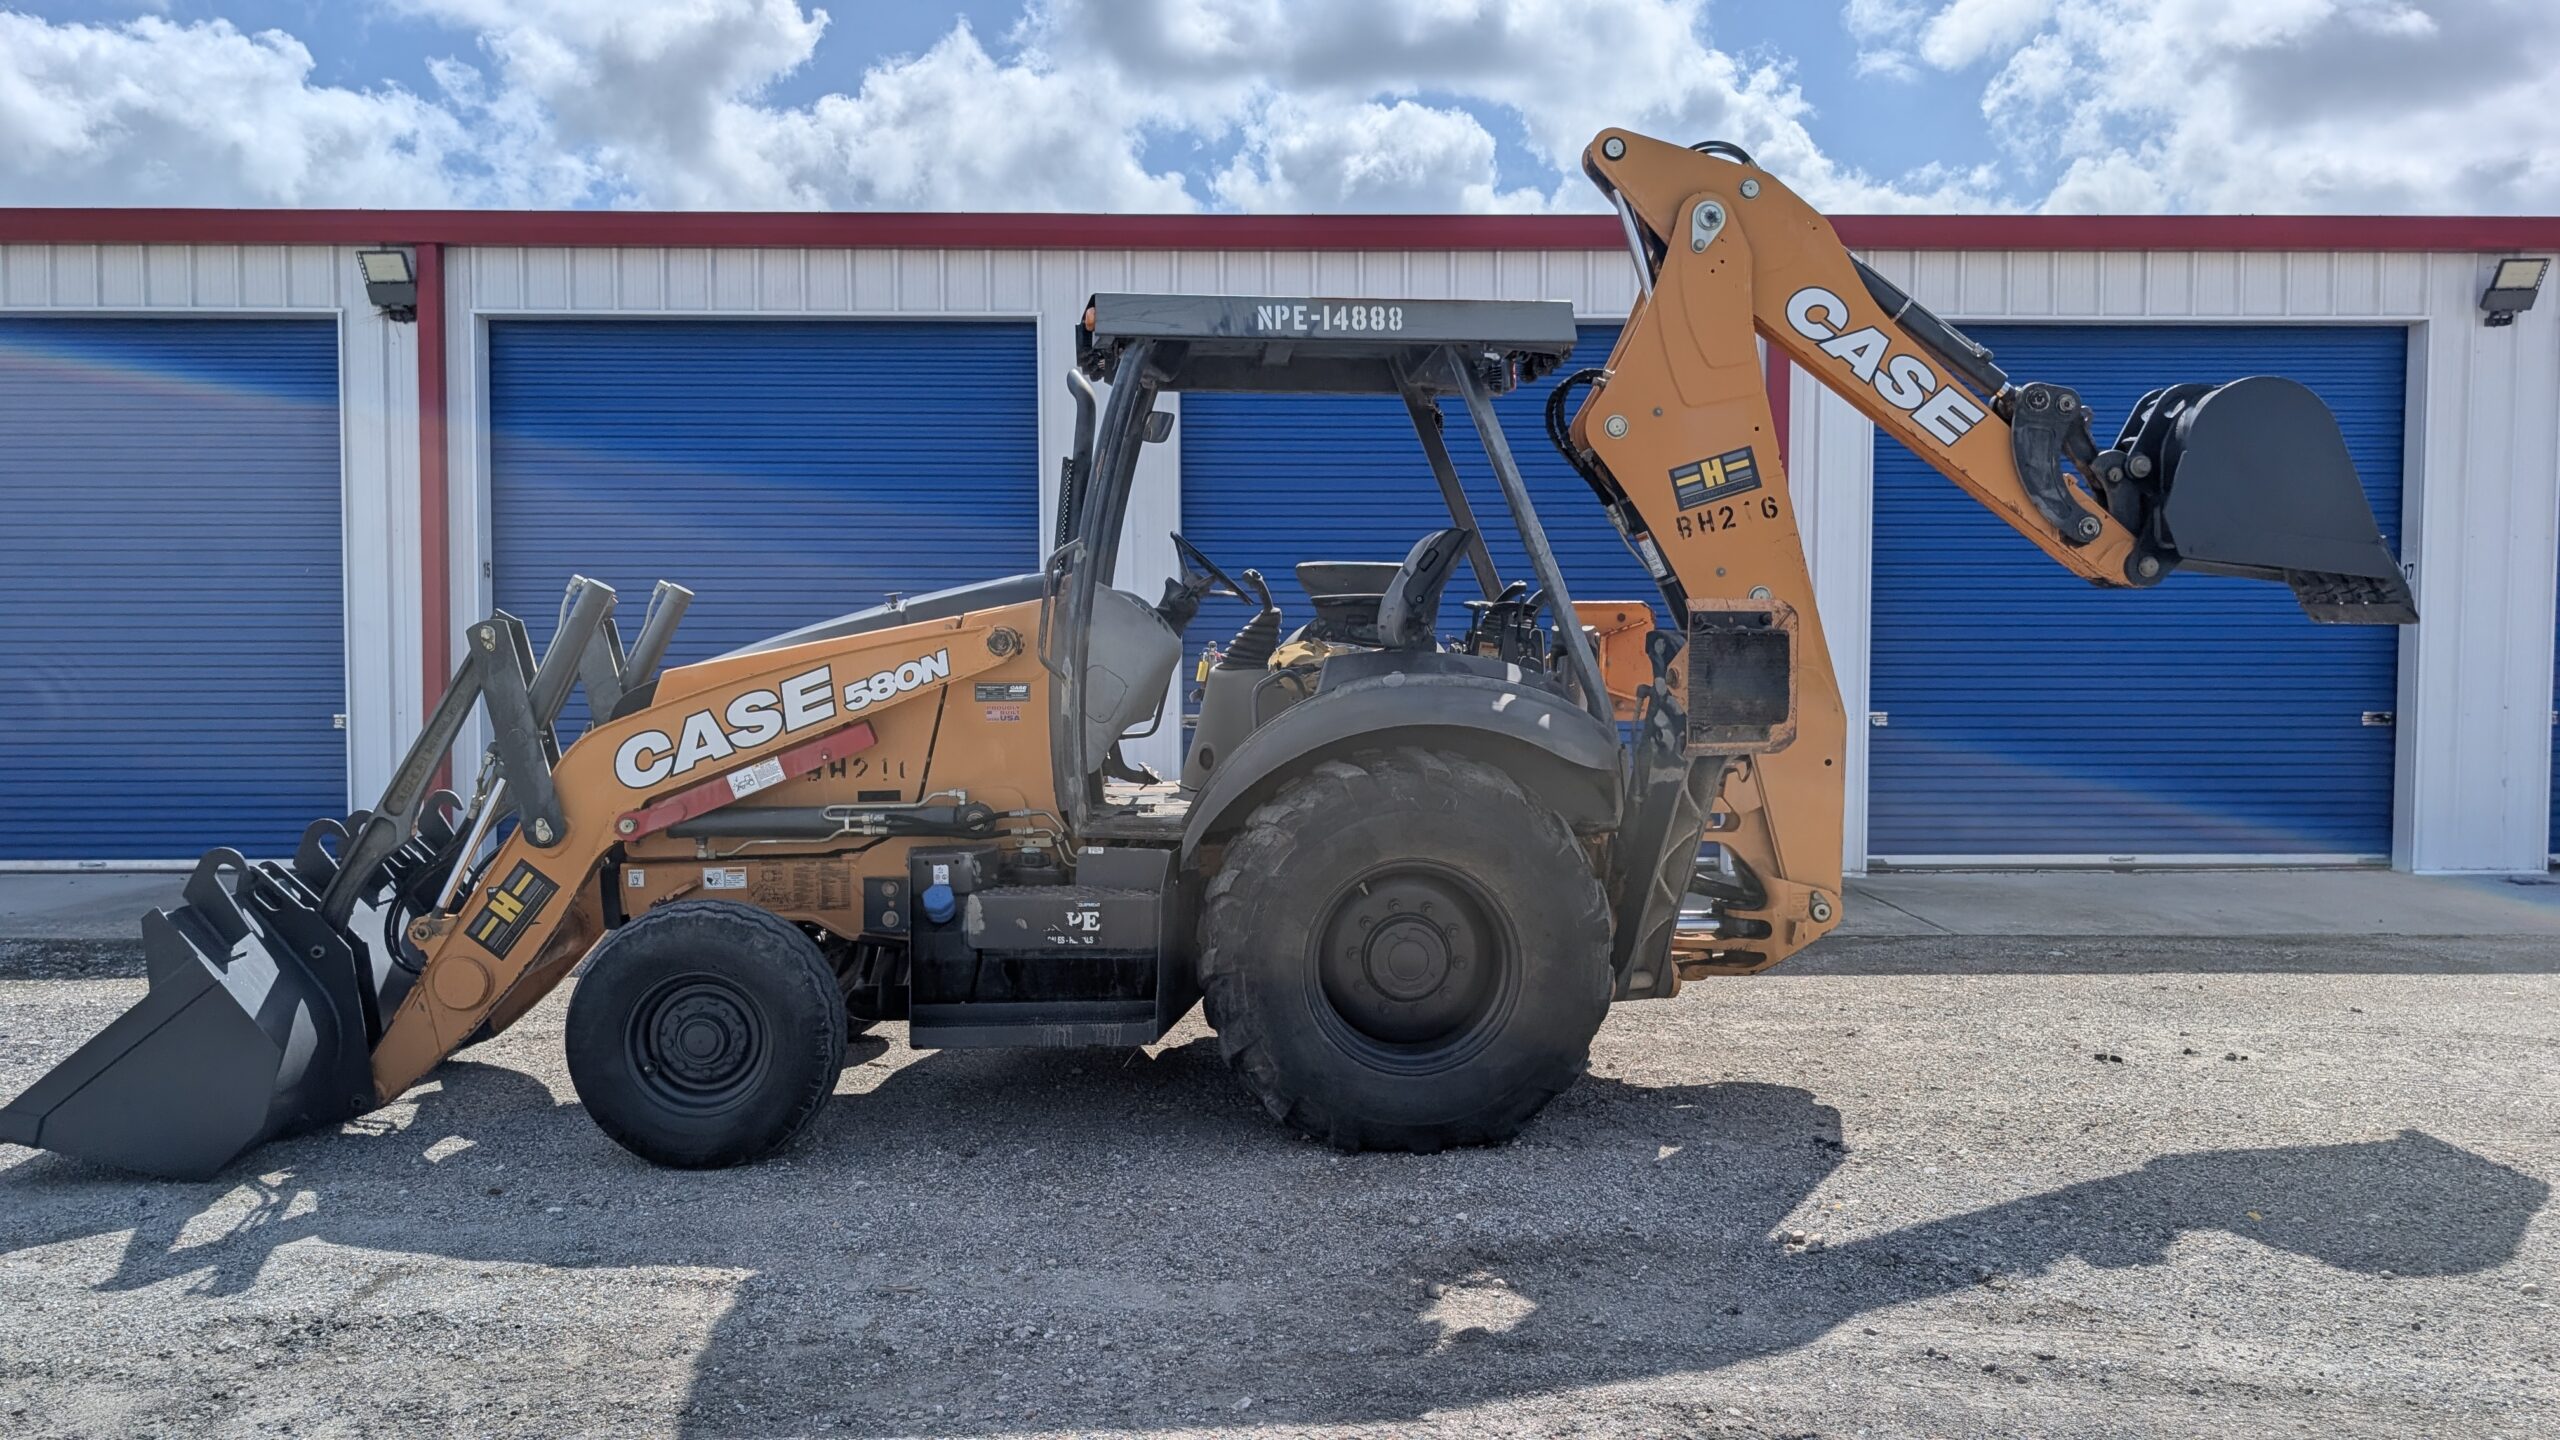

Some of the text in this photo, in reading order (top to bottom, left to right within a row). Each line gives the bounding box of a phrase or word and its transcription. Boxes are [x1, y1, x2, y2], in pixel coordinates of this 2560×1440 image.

[1257, 305, 1403, 331] NPE-14888
[1785, 286, 1988, 447] CASE
[1700, 458, 1726, 488] H
[1676, 496, 1778, 540] BH26
[2403, 563, 2415, 581] 17
[614, 648, 950, 789] CASE 580N
